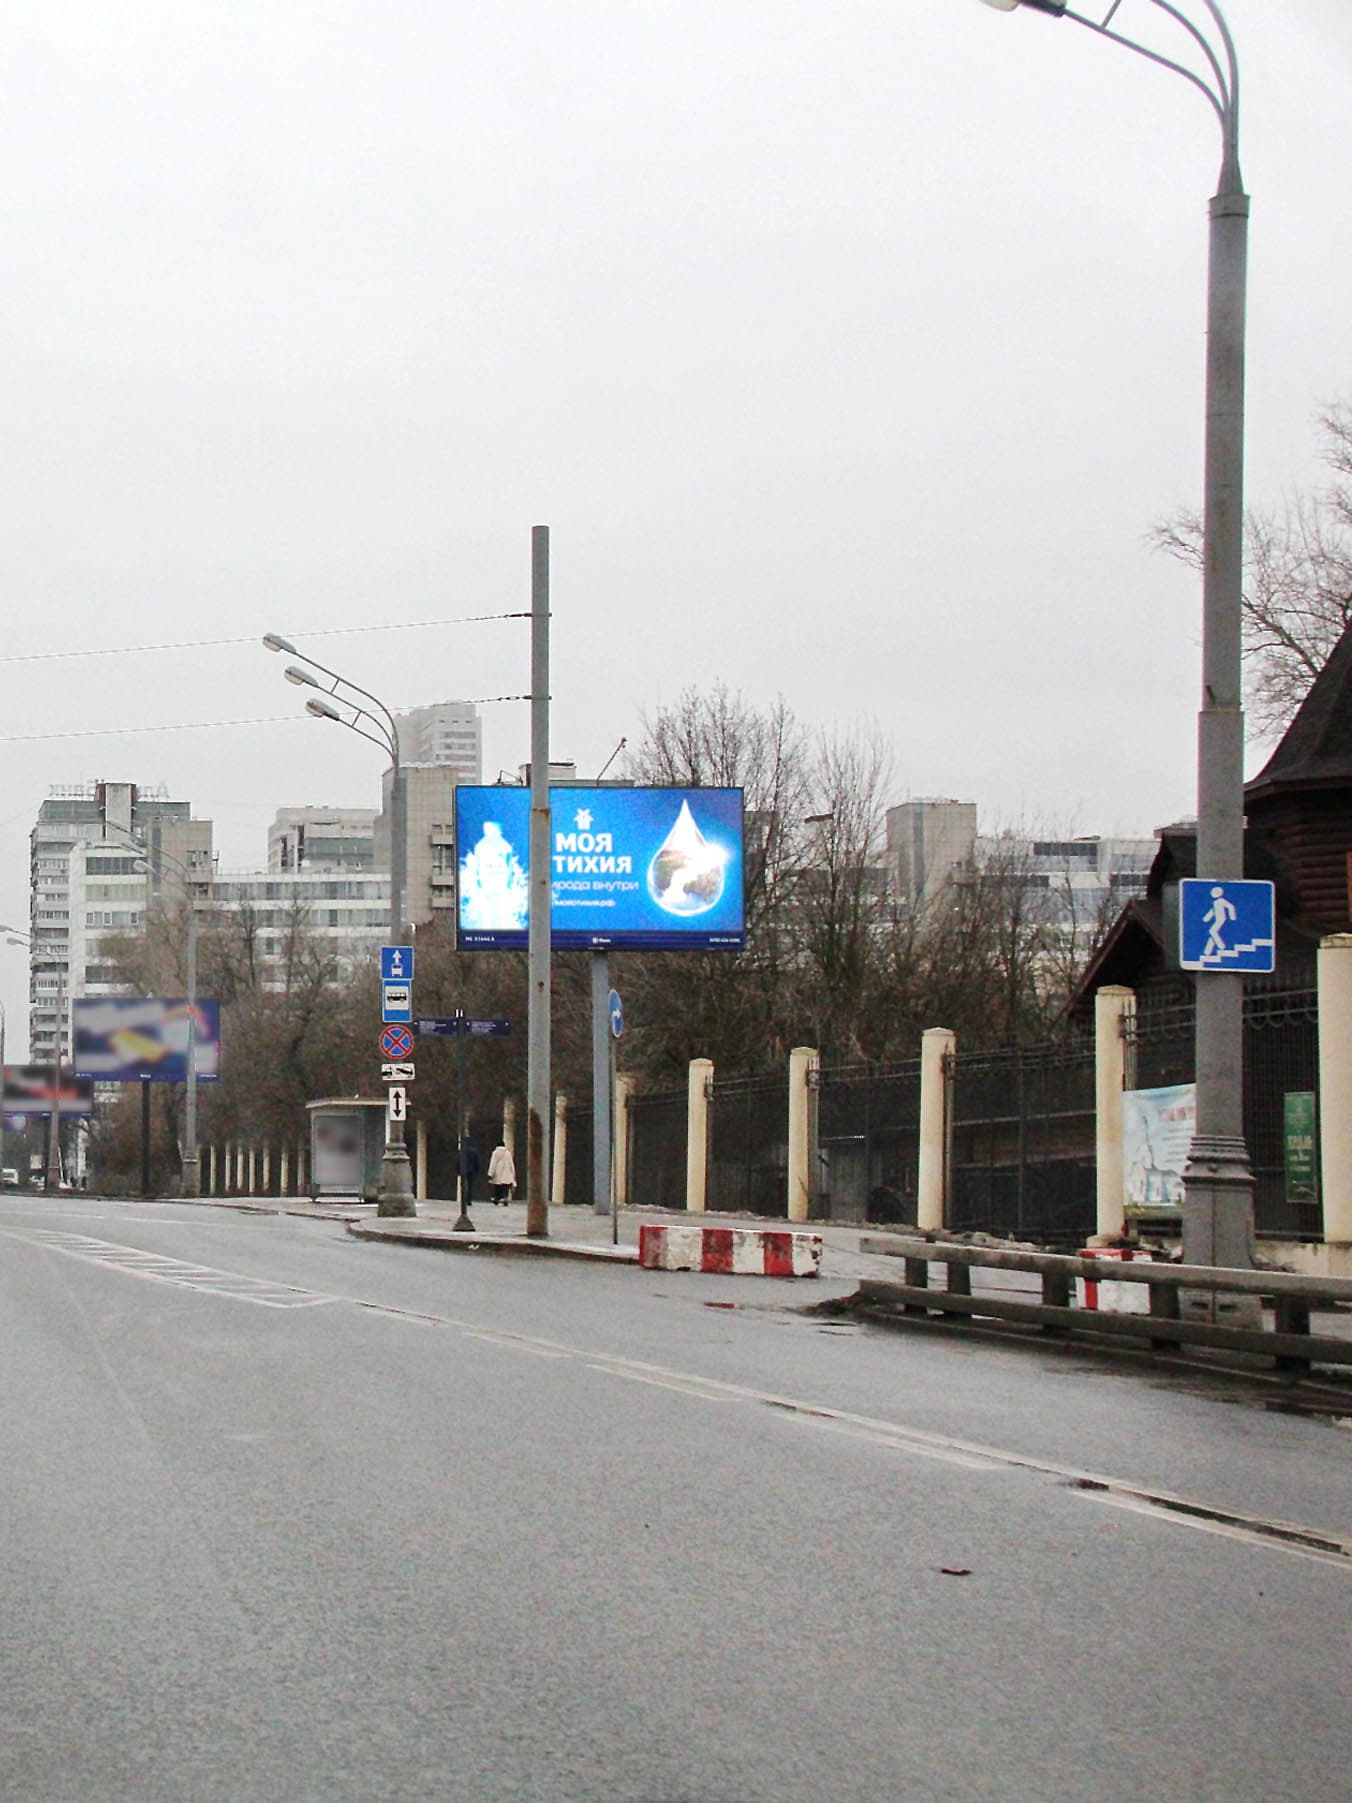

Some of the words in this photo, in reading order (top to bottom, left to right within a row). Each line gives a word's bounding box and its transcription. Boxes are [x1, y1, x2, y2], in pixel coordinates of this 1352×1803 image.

[555, 832, 613, 853] МОЯ
[552, 855, 632, 873] ТИХИЯ
[592, 880, 639, 892] внутри
